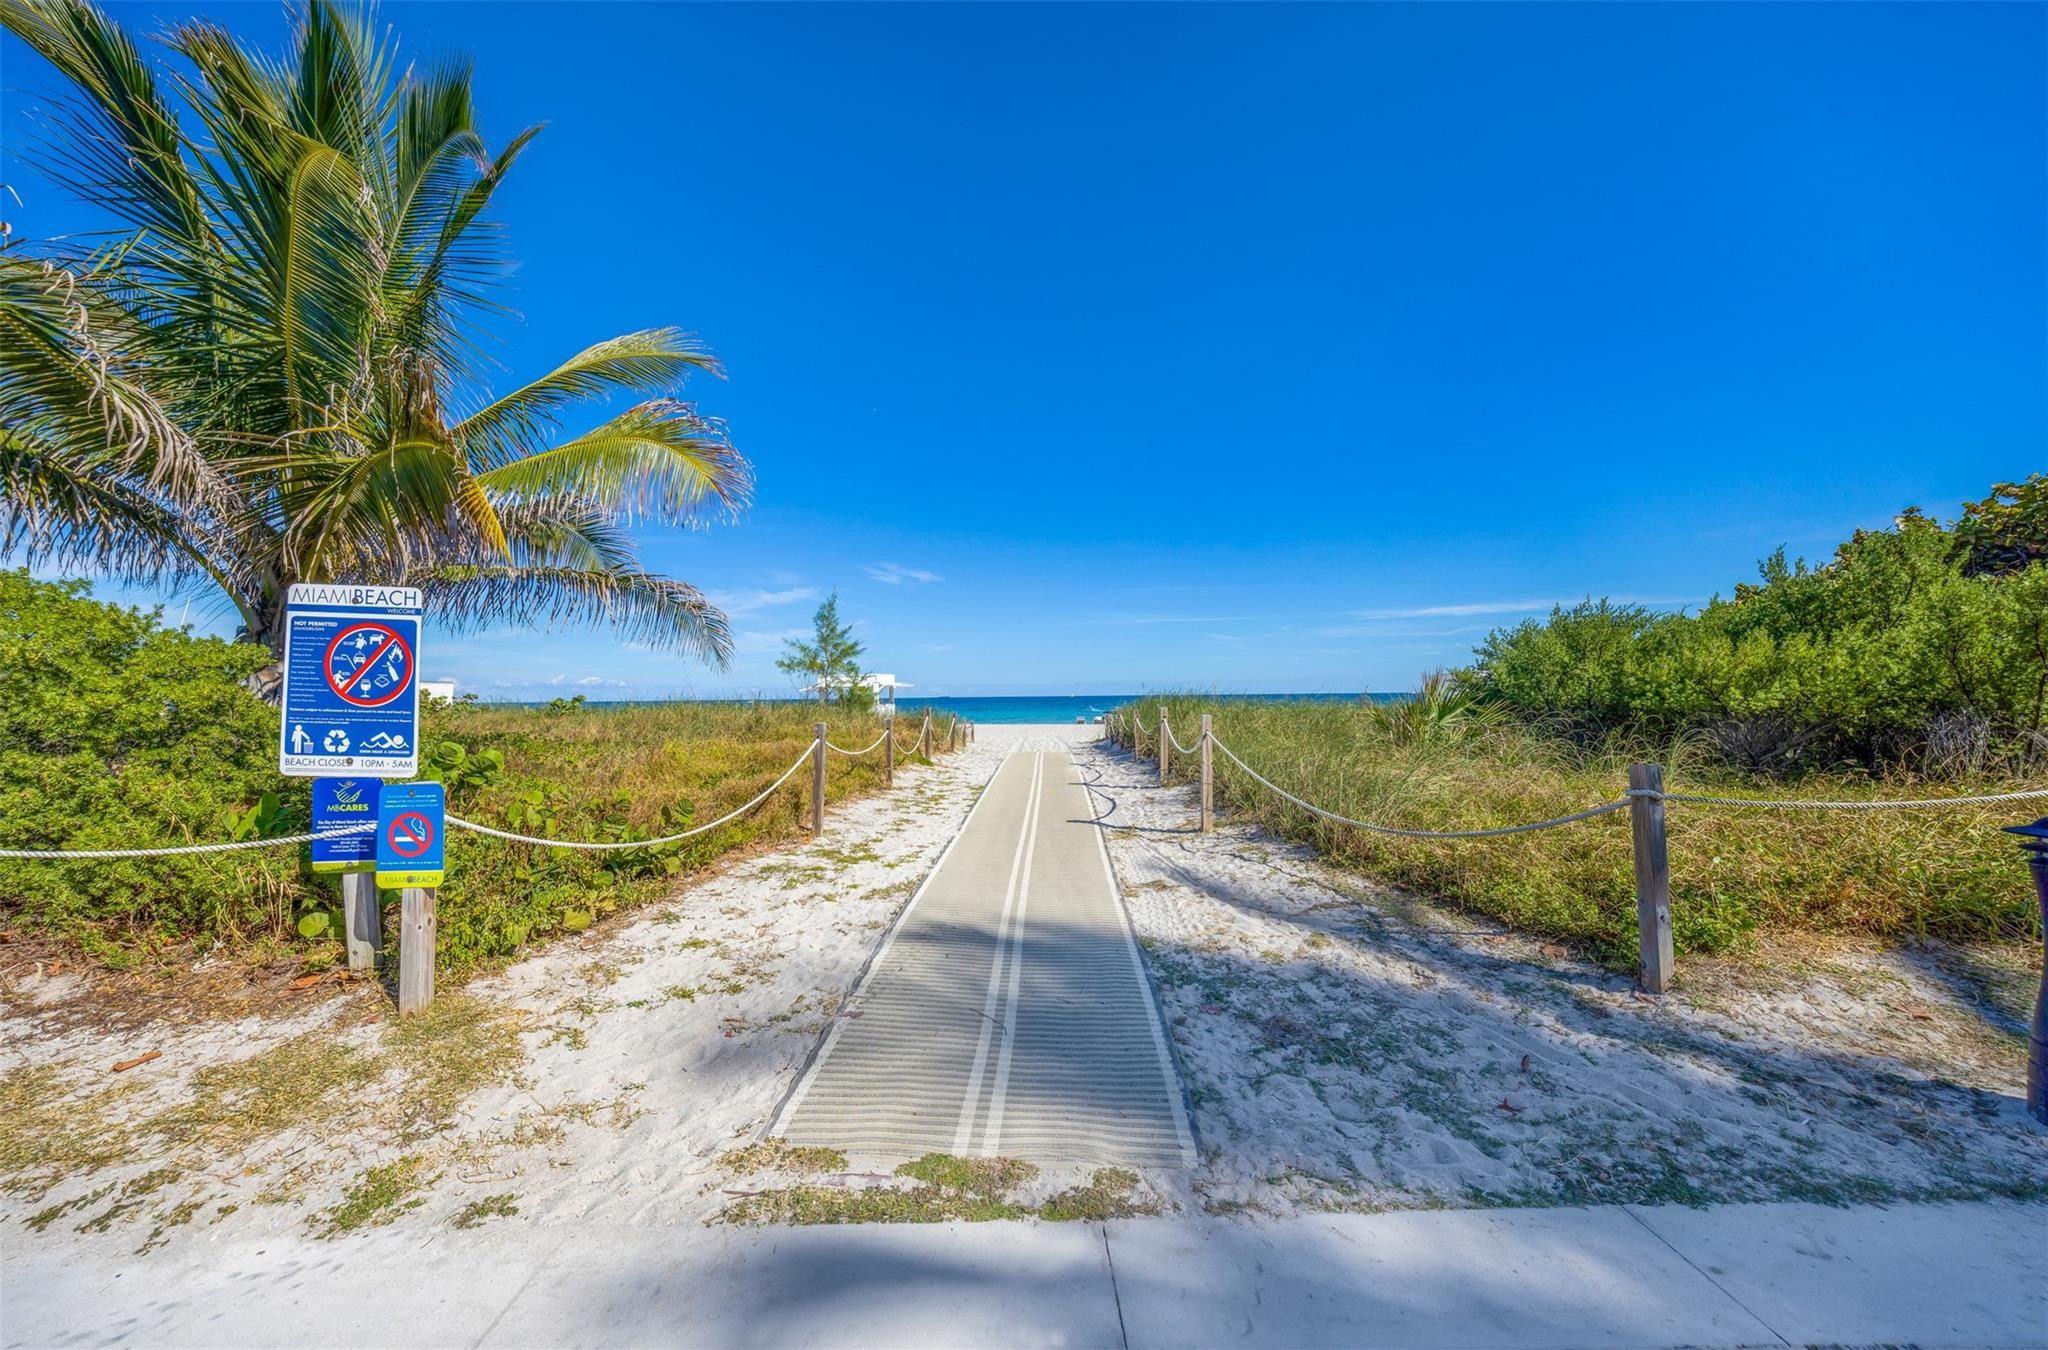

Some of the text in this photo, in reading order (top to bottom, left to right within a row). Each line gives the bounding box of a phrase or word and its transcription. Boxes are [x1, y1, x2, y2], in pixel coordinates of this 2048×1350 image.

[284, 757, 316, 766] BEACH
[317, 758, 353, 767] CLOSE
[361, 759, 385, 768] 10PM
[391, 760, 413, 768] 5AM
